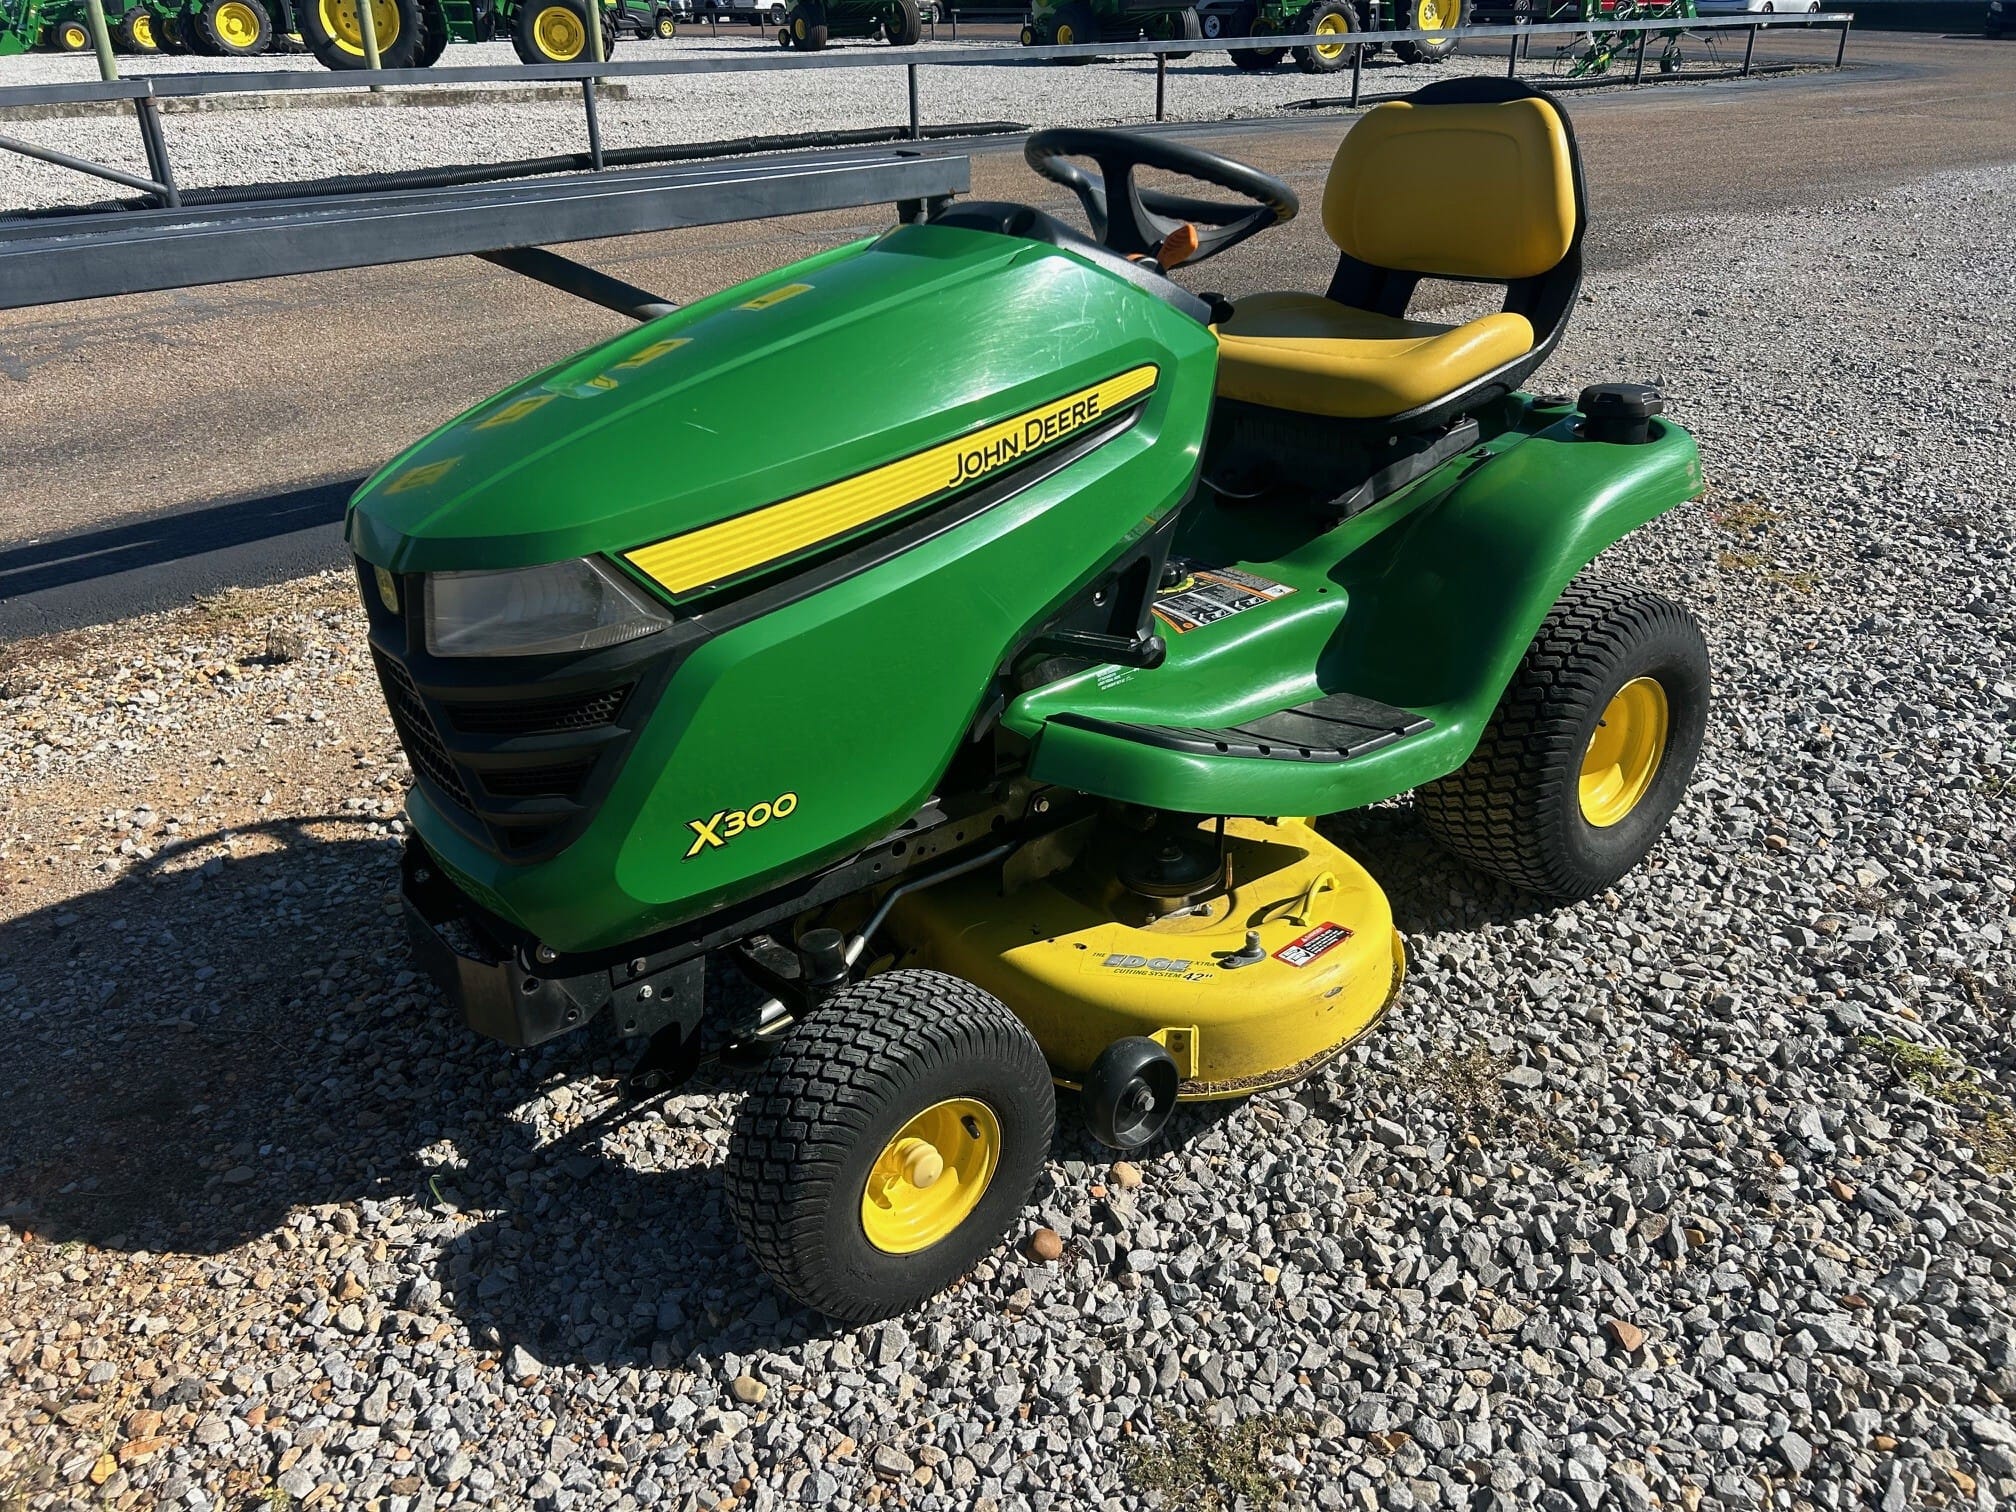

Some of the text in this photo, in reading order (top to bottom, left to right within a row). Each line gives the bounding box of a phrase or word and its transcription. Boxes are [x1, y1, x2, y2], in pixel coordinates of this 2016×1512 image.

[949, 393, 1100, 484] JOHN DEERE
[683, 792, 798, 860] X300
[1102, 954, 1193, 973] EDGE
[1190, 960, 1216, 968] EXTRA
[1113, 968, 1214, 981] CUTTING SYSTEM 42"
